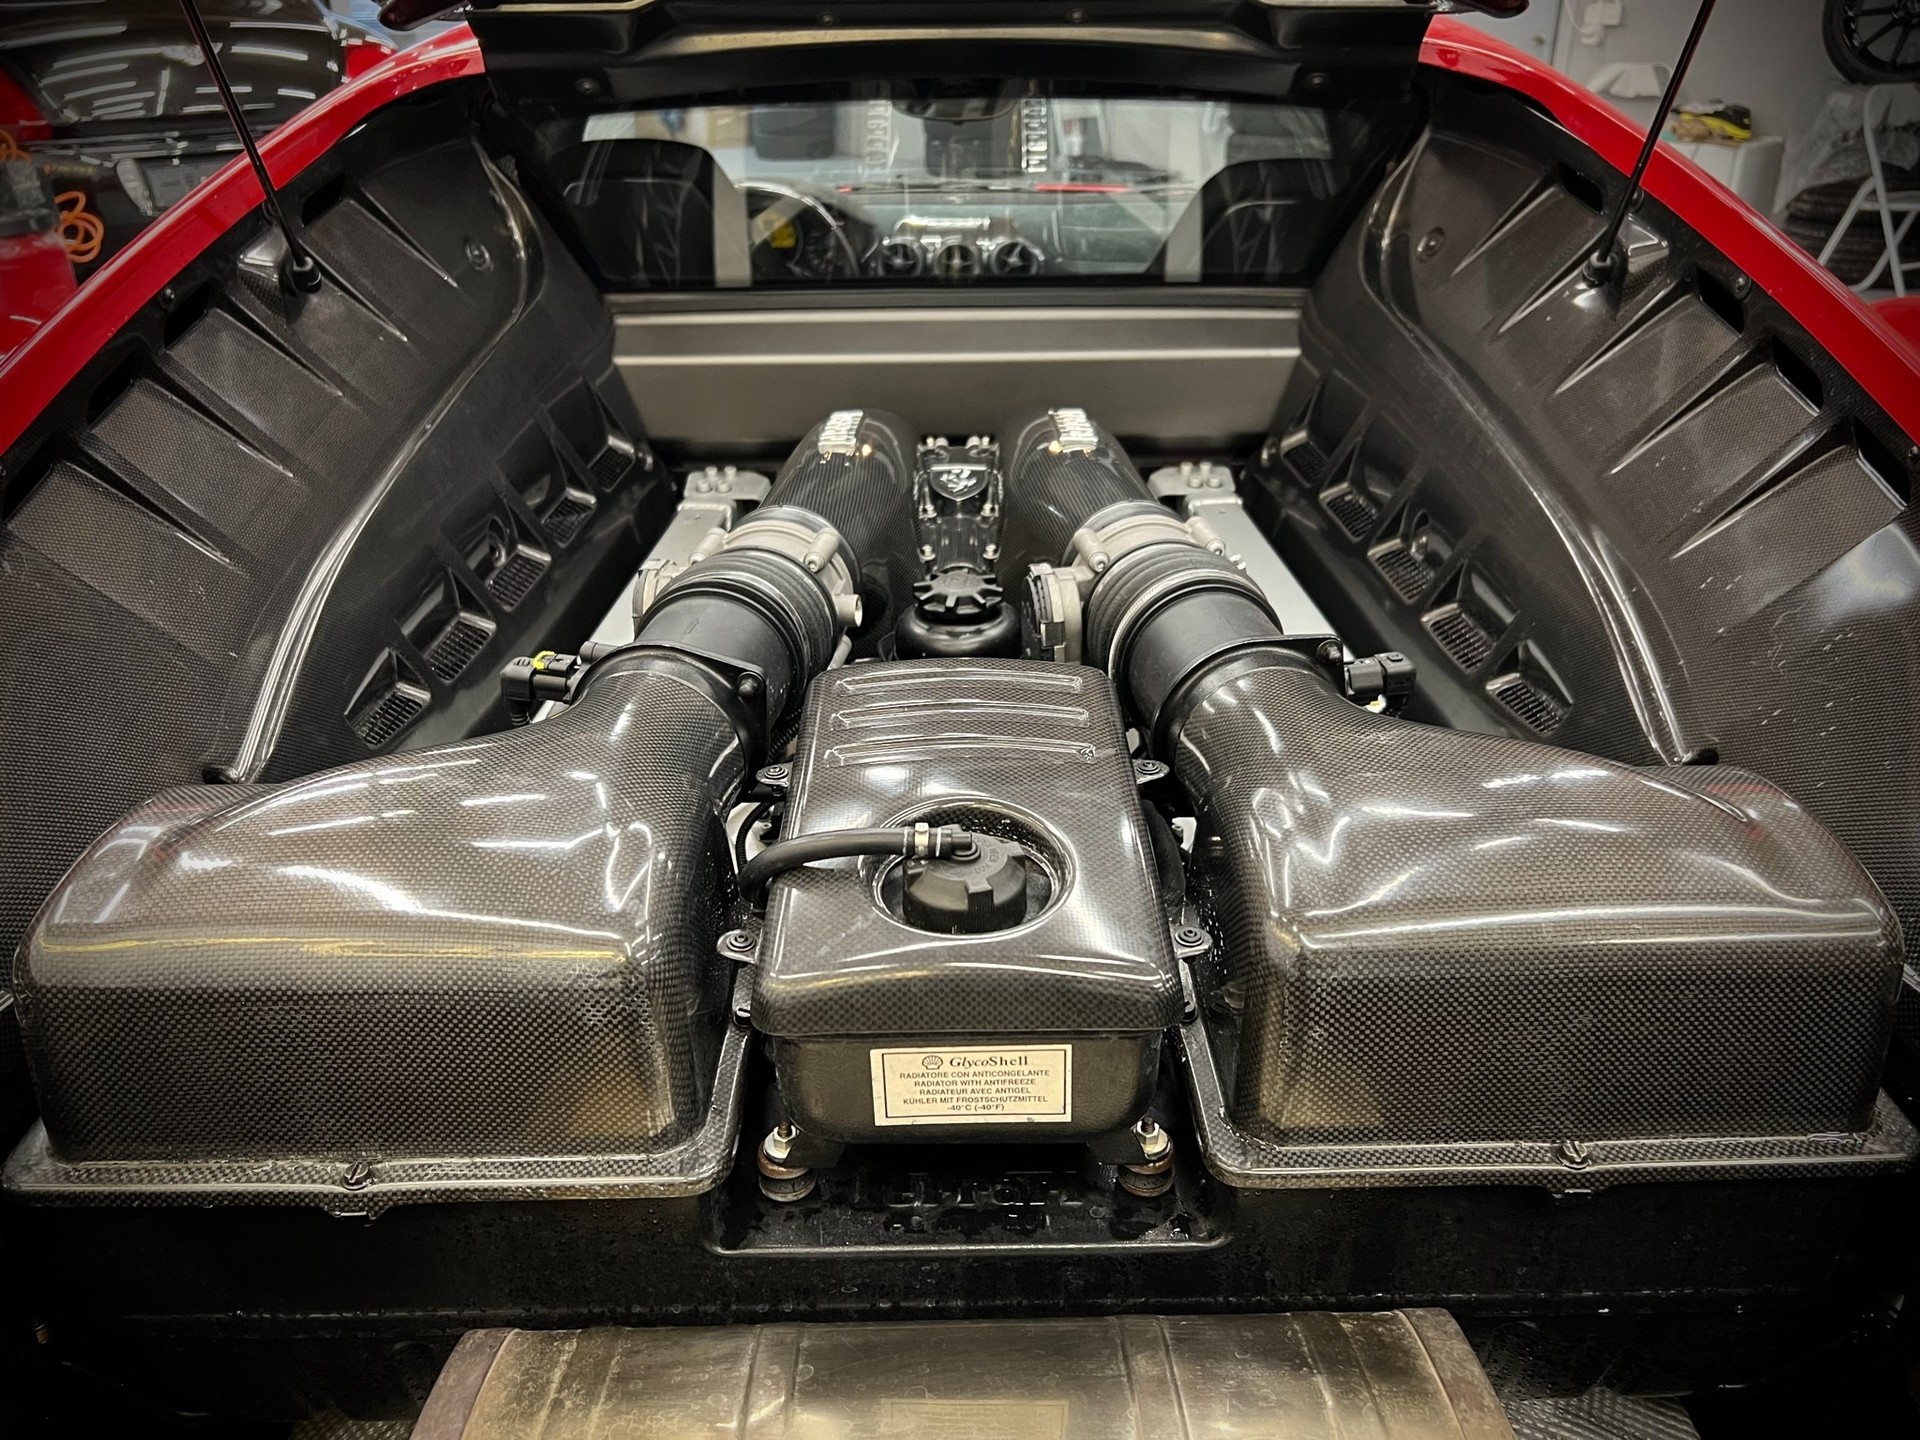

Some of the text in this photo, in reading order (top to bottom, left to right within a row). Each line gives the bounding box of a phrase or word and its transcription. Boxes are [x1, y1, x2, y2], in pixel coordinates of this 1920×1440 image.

[949, 1056, 1028, 1069] GlycoShell
[899, 1069, 1050, 1079] RADIATORE CON ANTICONGELANTE
[983, 1078, 1036, 1086] ANTIFREEZE
[919, 1088, 968, 1096] RADIATEUR
[903, 1095, 1048, 1105] KÜHLER MIT FROSTSCHUTZMITTEL
[946, 1103, 1005, 1111] -40°C (-40°F)
